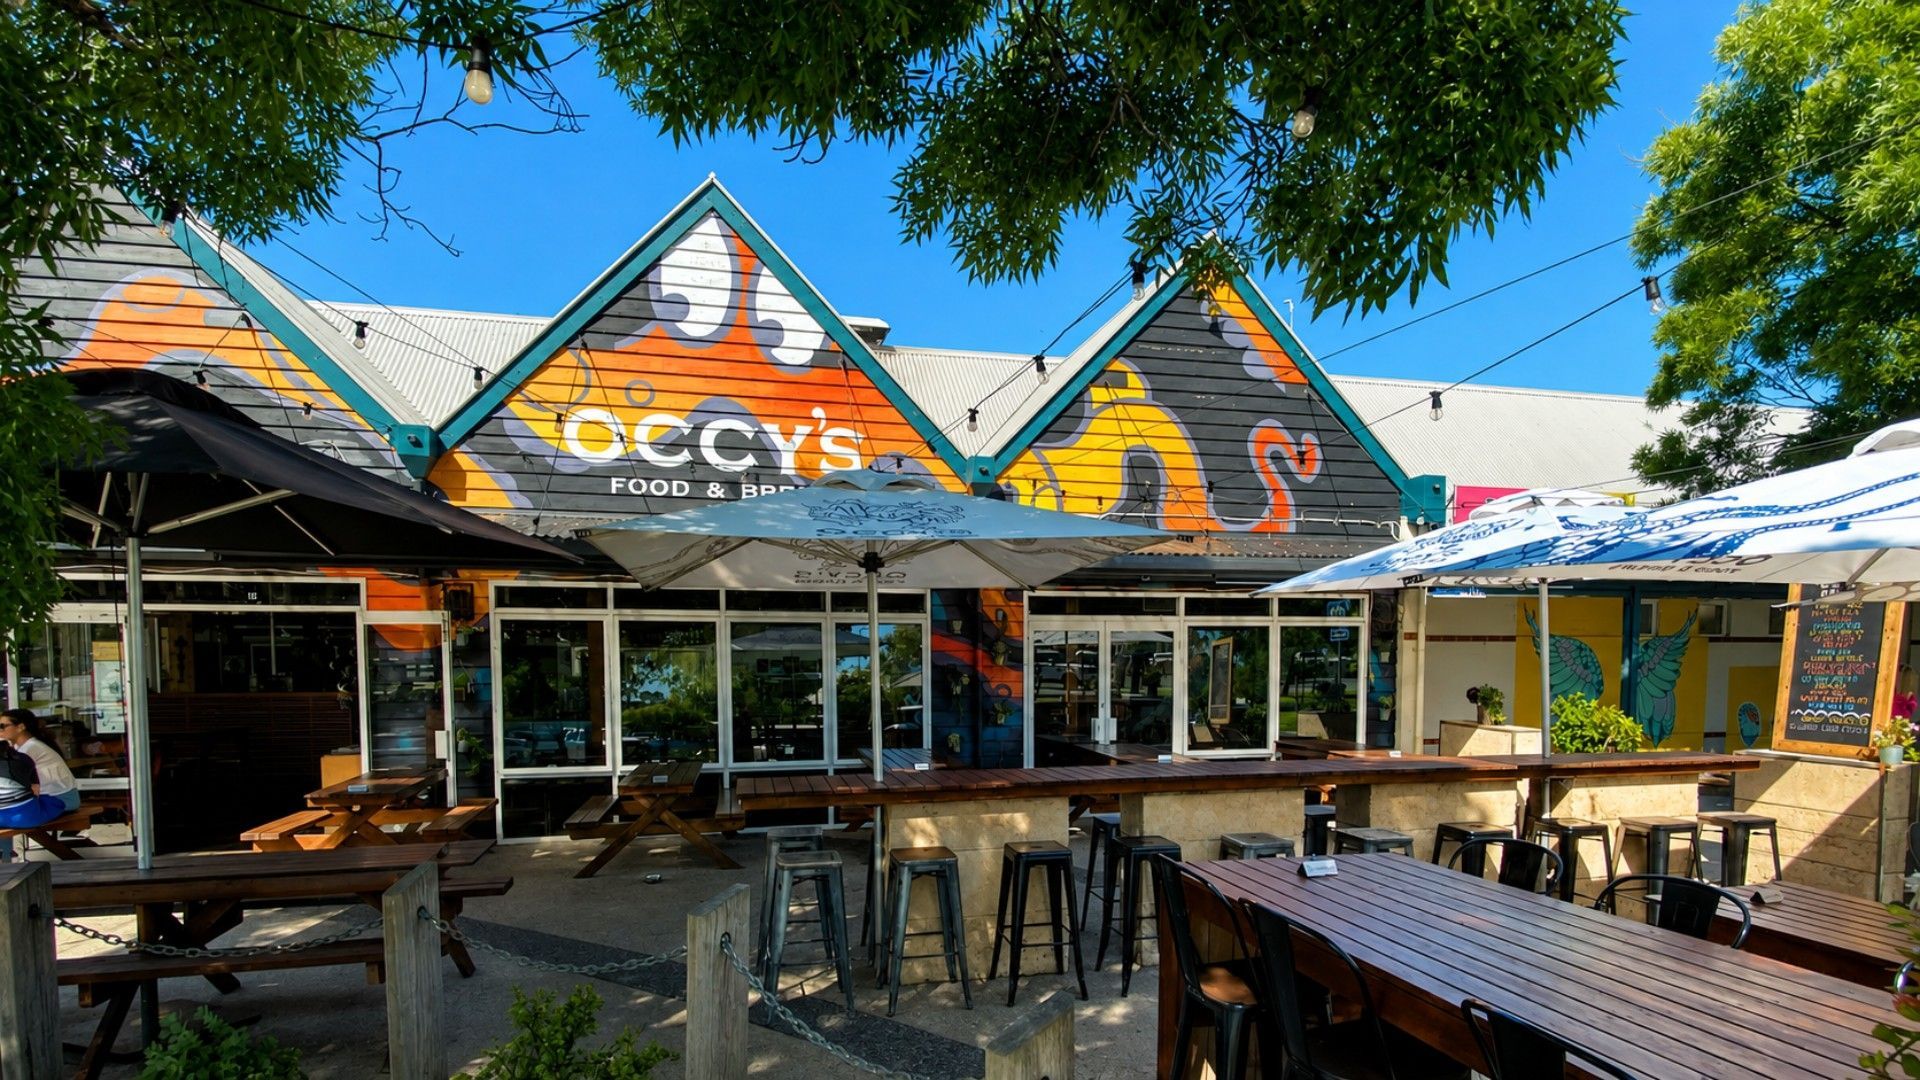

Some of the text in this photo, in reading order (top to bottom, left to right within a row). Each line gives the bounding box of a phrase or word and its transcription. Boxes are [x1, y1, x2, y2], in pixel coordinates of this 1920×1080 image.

[564, 407, 865, 476] OCCY'S
[610, 477, 690, 497] FOOD
[706, 482, 726, 498] &
